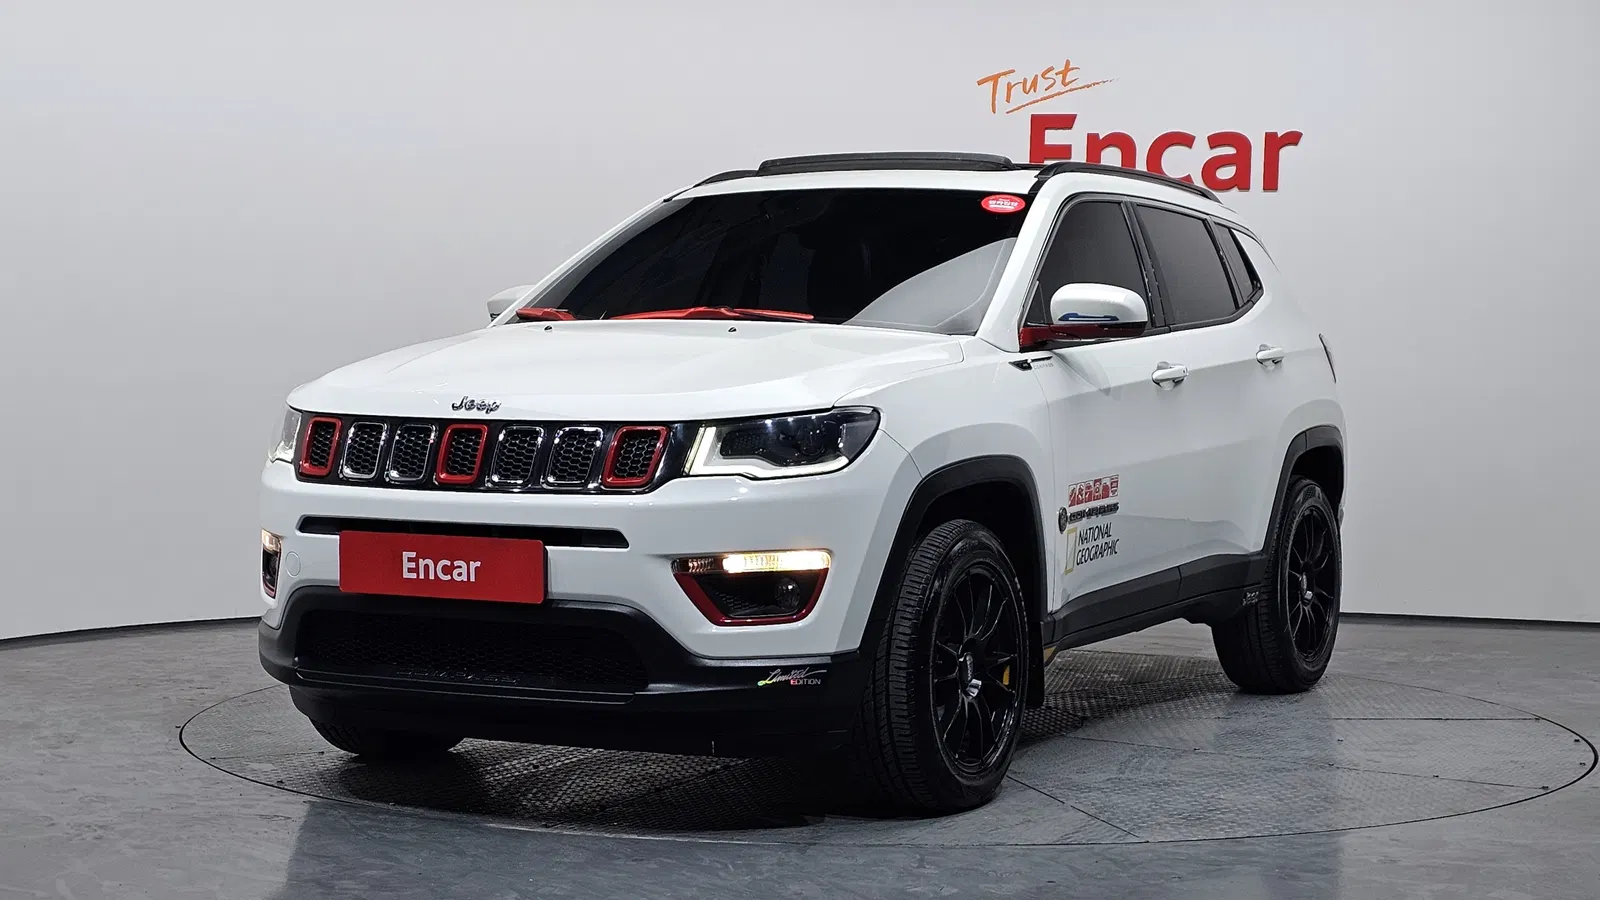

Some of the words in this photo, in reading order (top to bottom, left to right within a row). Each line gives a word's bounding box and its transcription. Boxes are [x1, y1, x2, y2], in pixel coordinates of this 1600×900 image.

[977, 59, 1084, 114] Trust
[1029, 113, 1304, 192] Encar
[451, 396, 502, 414] Jeep
[1078, 522, 1113, 546] NATIONAL
[402, 551, 481, 582] Encar
[1076, 540, 1120, 566] GEOGRAPHIC
